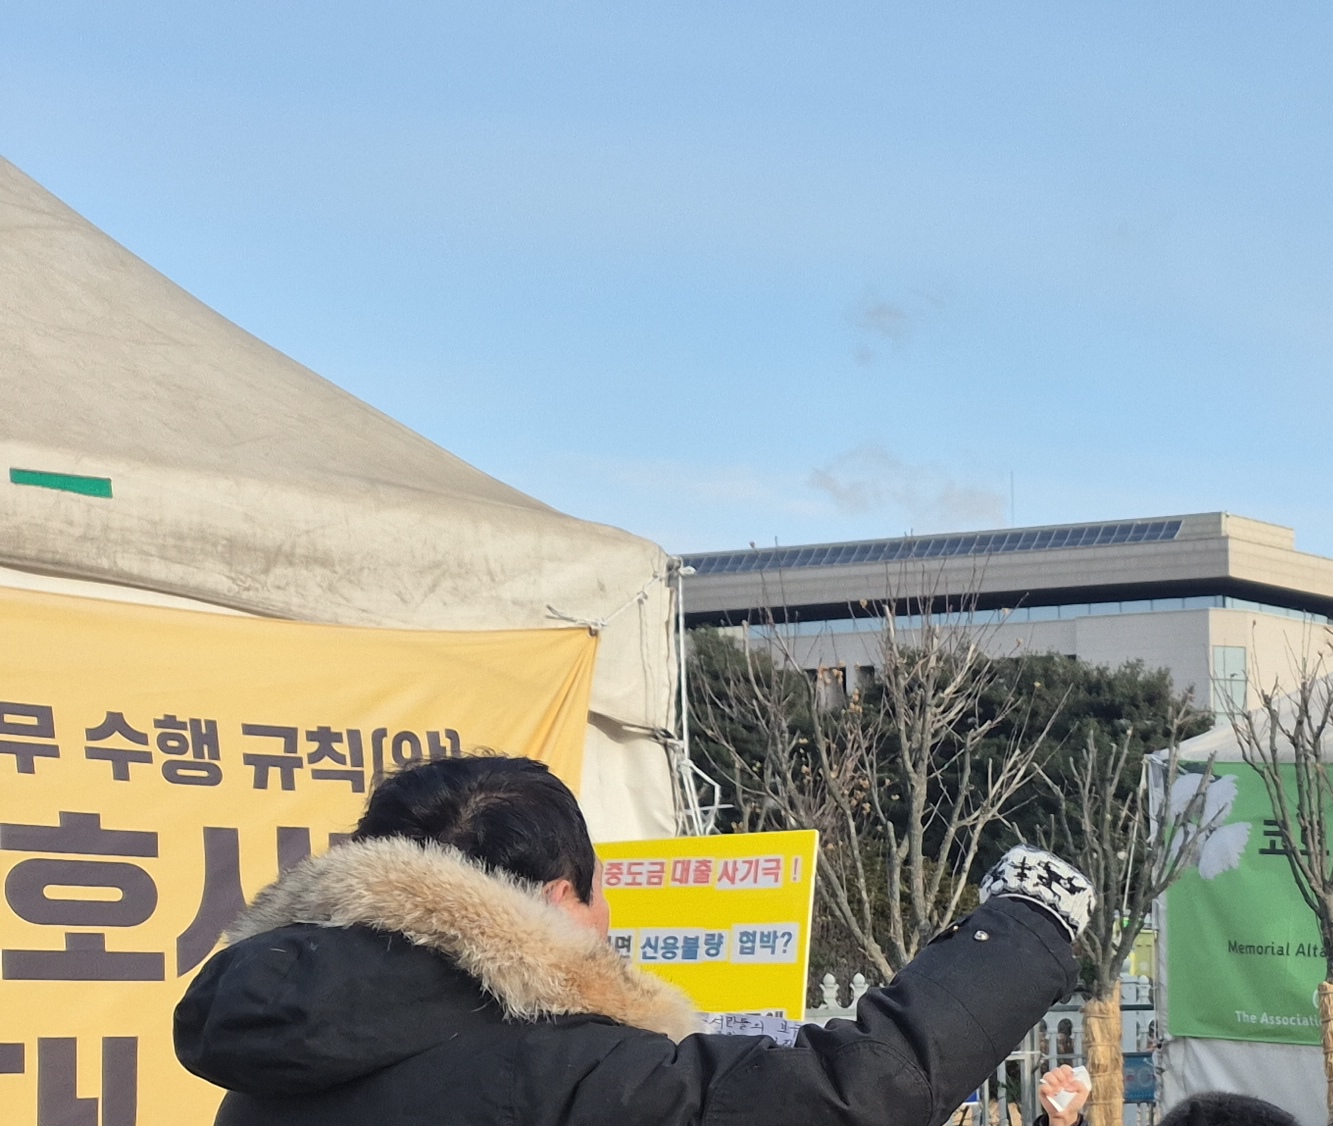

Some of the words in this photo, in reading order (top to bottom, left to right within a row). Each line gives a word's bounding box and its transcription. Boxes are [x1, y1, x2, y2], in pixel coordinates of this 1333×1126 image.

[84, 711, 223, 790] 수행
[603, 861, 666, 887] 중도금
[670, 858, 713, 885] 대출
[717, 856, 782, 886] 사기극
[640, 932, 725, 961] 신용불량
[738, 929, 794, 956] 협박?
[1228, 940, 1290, 957] Memorial
[1295, 943, 1328, 959] Alta
[1235, 1010, 1257, 1024] The
